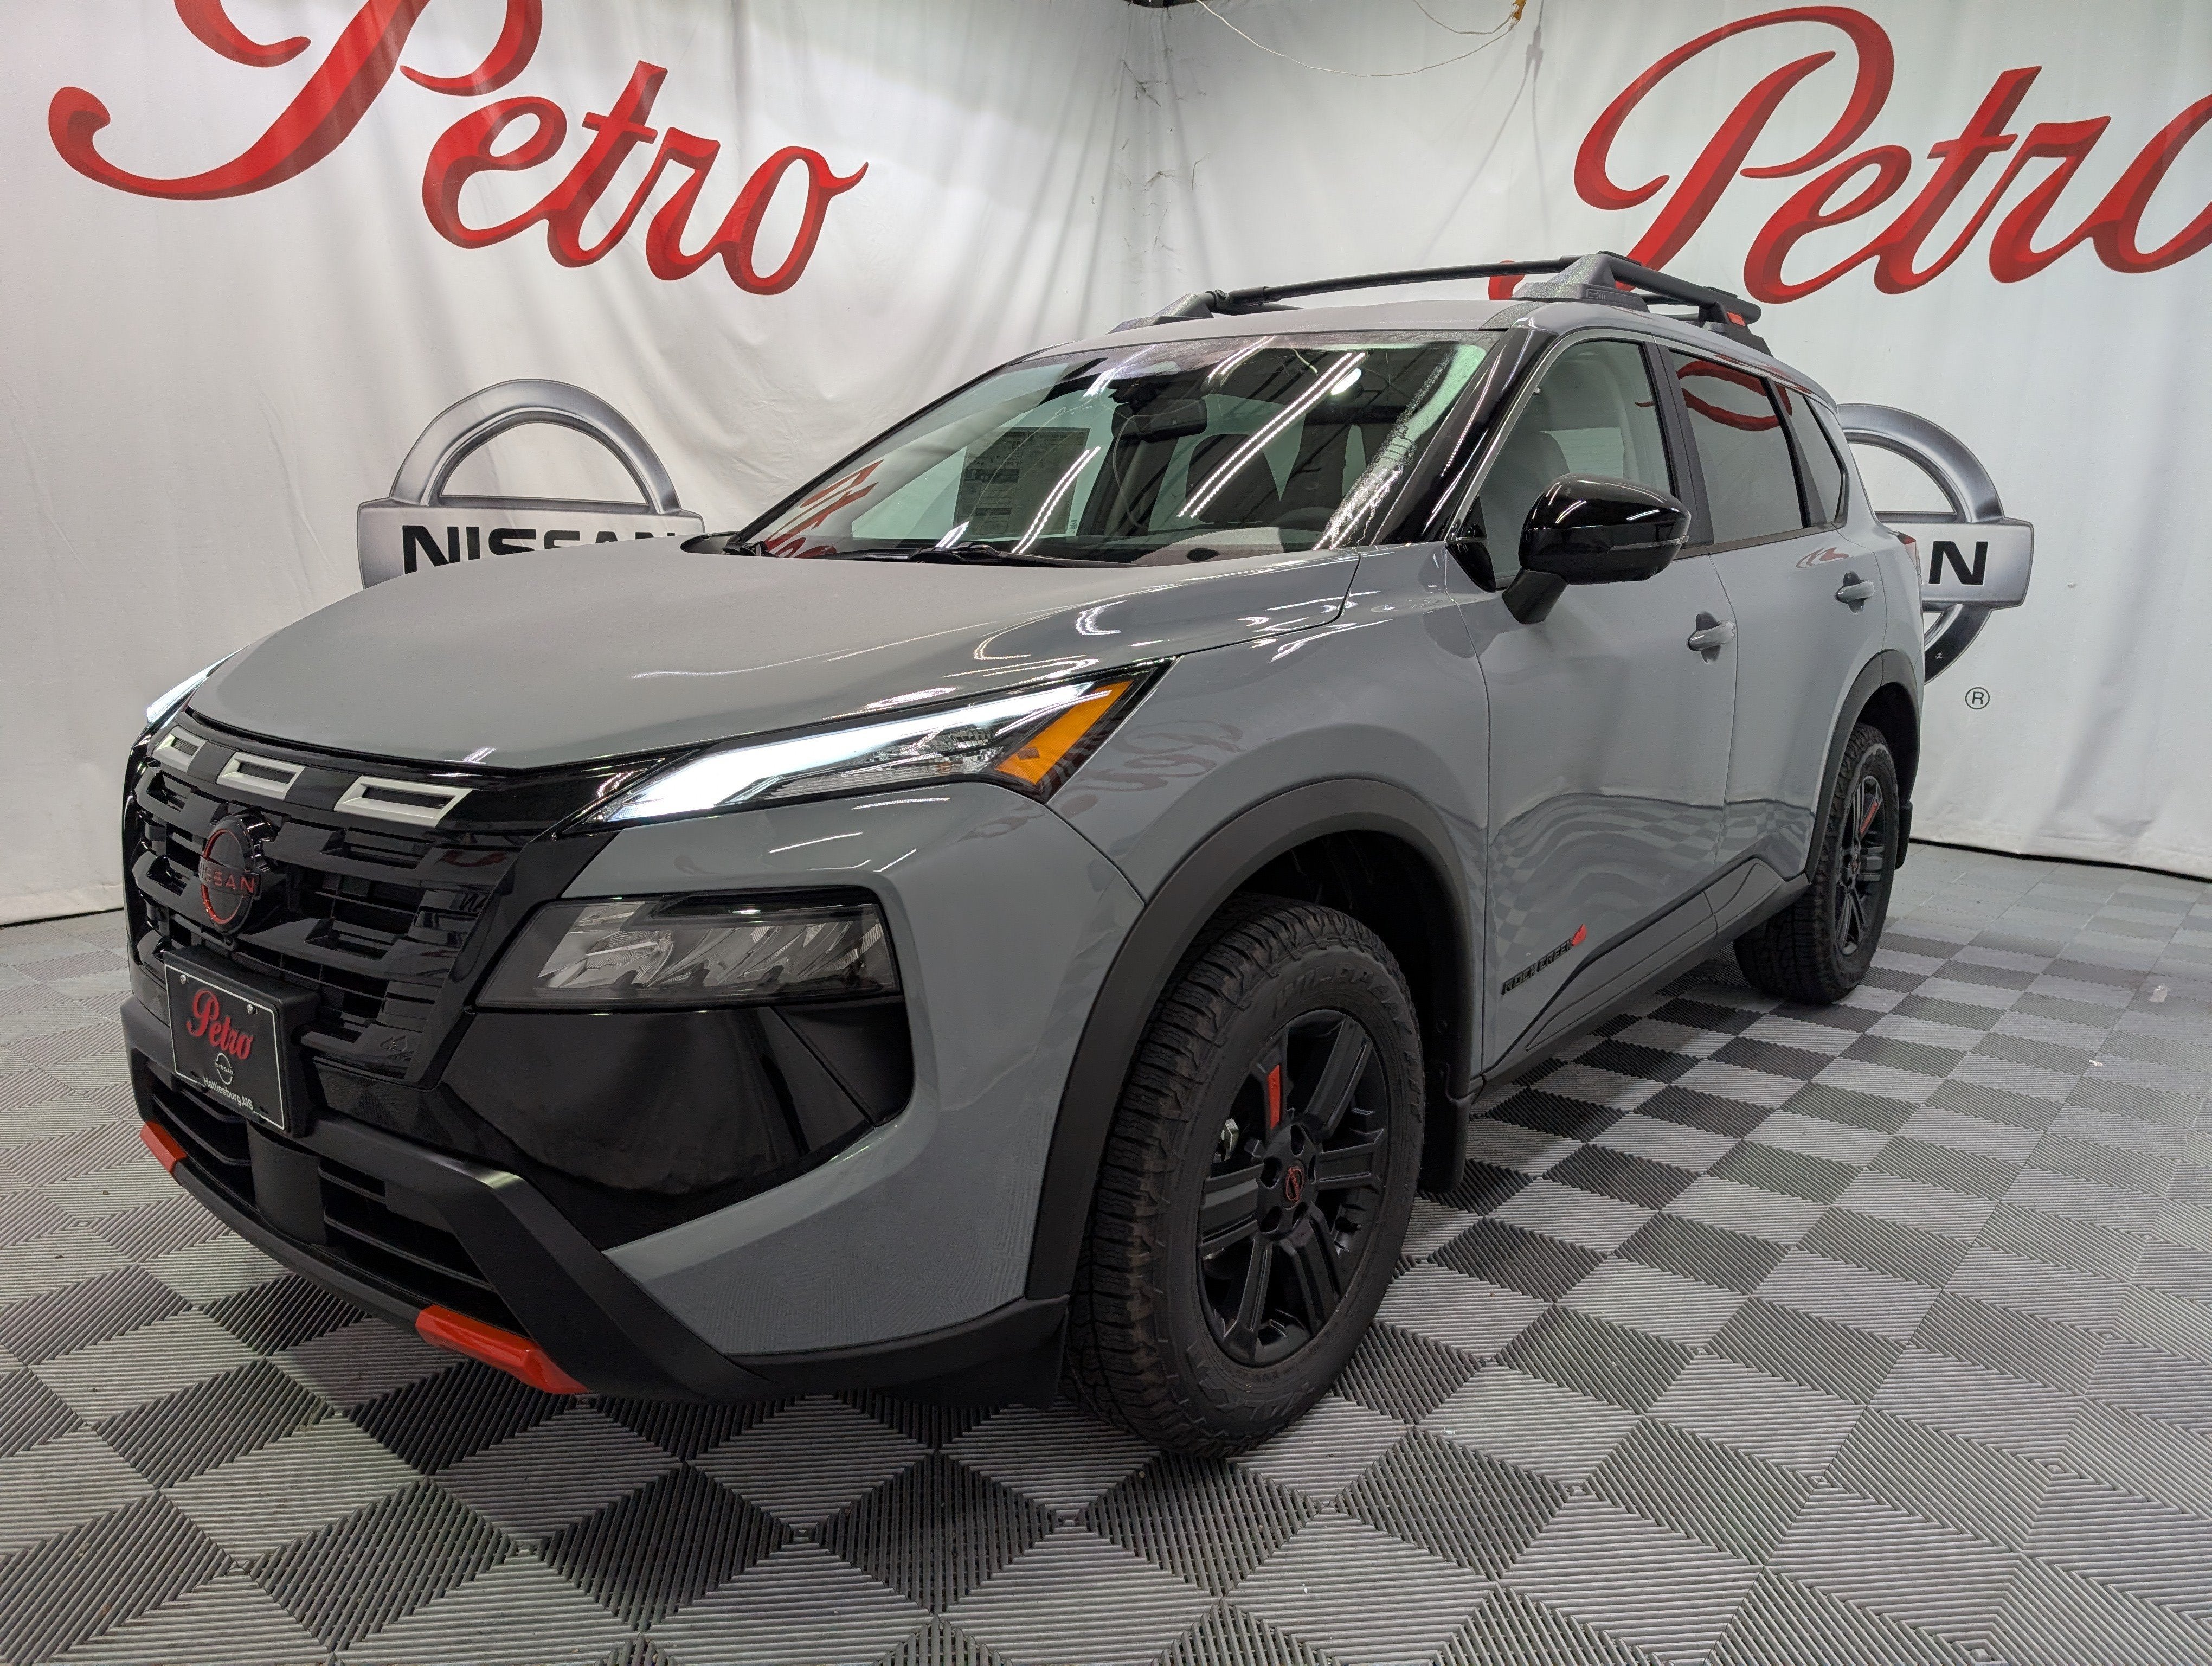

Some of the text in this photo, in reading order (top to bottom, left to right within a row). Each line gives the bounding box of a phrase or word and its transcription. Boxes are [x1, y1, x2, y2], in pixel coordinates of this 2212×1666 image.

[48, 0, 869, 296] Petro
[187, 989, 254, 1060] Petro
[215, 1062, 234, 1076] NISSAN
